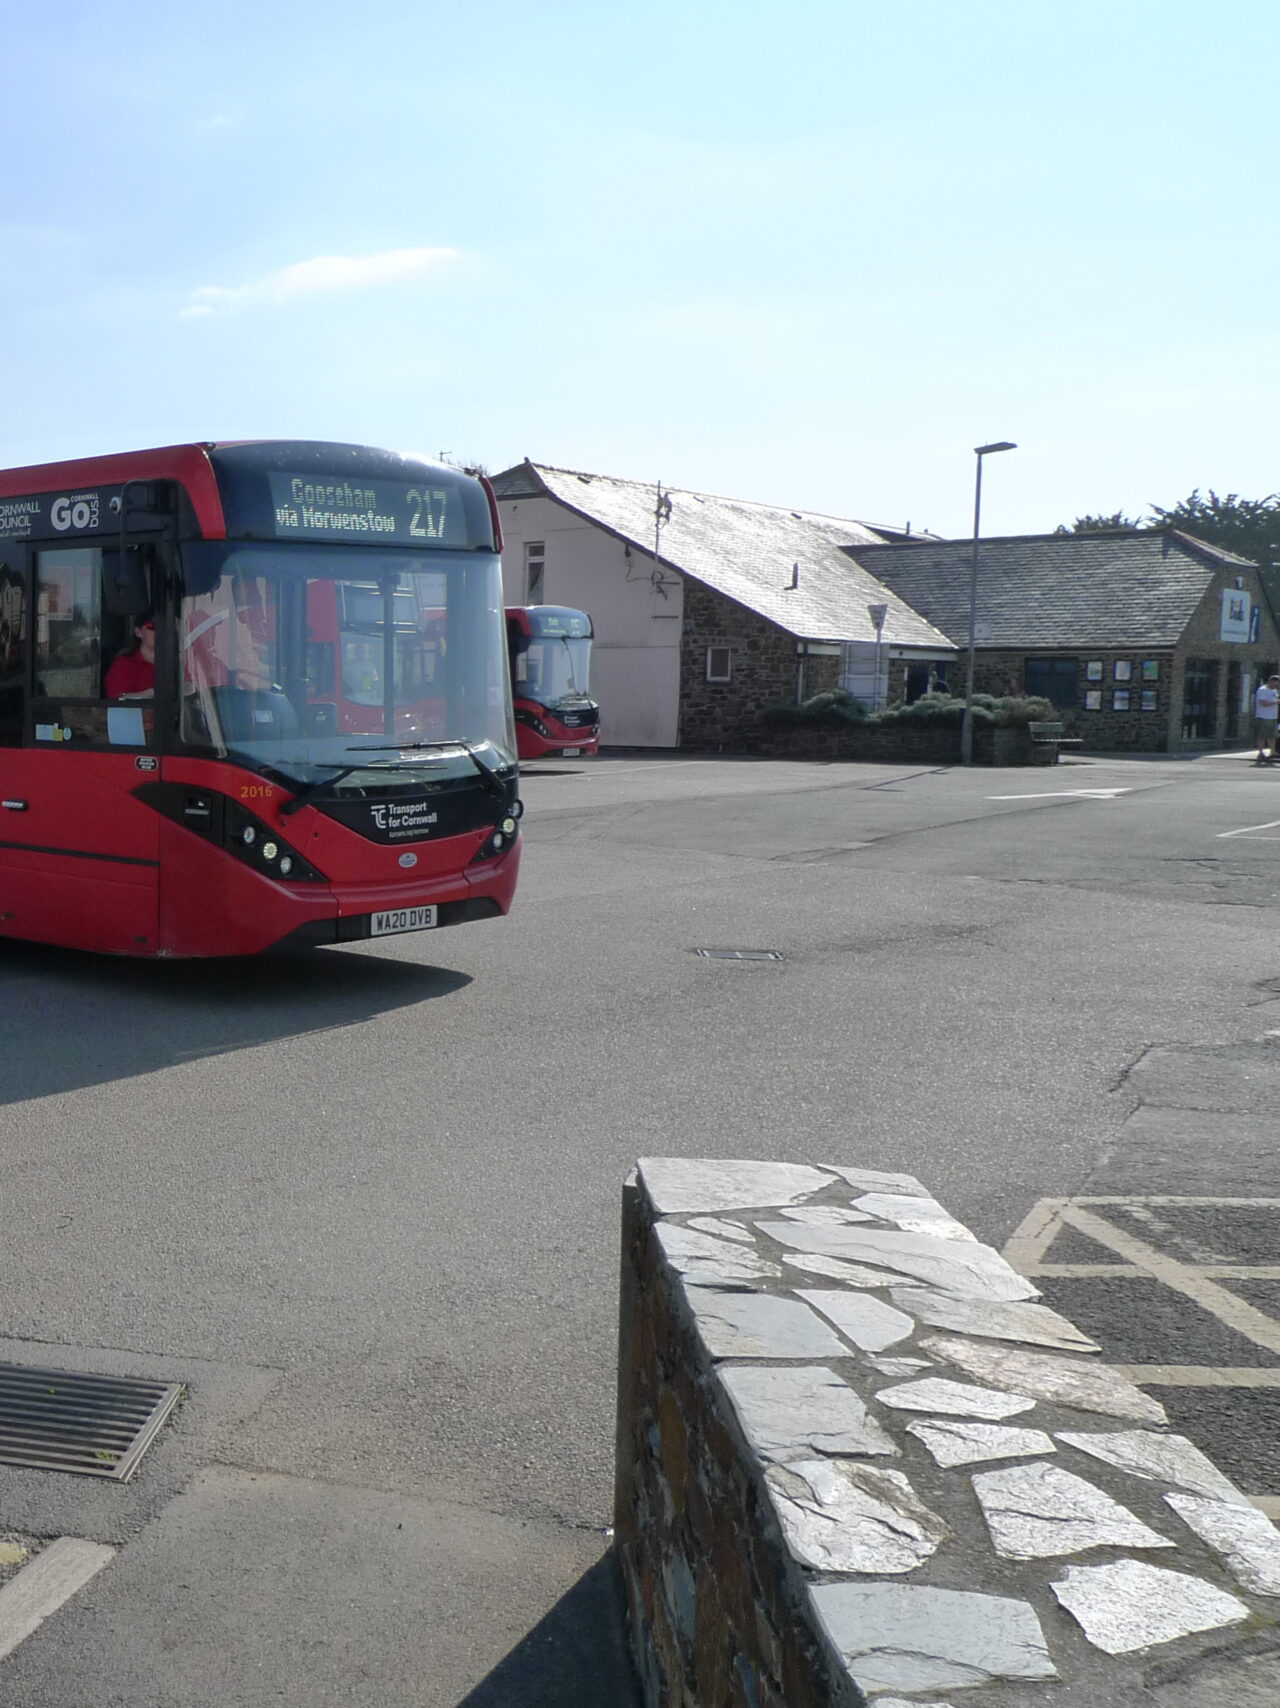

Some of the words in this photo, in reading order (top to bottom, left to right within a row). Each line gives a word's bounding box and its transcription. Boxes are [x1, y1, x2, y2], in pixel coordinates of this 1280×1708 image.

[71, 493, 99, 502] CORNWALL
[291, 479, 376, 508] Gooseham
[276, 504, 298, 527] via
[302, 506, 395, 532] Morwenstow
[406, 489, 447, 537] 217
[241, 785, 273, 798] 2016
[388, 802, 427, 815] Transport
[388, 817, 400, 827] for
[402, 812, 437, 826] Cornwall
[377, 912, 406, 931] WA20
[410, 908, 431, 926] DVB
